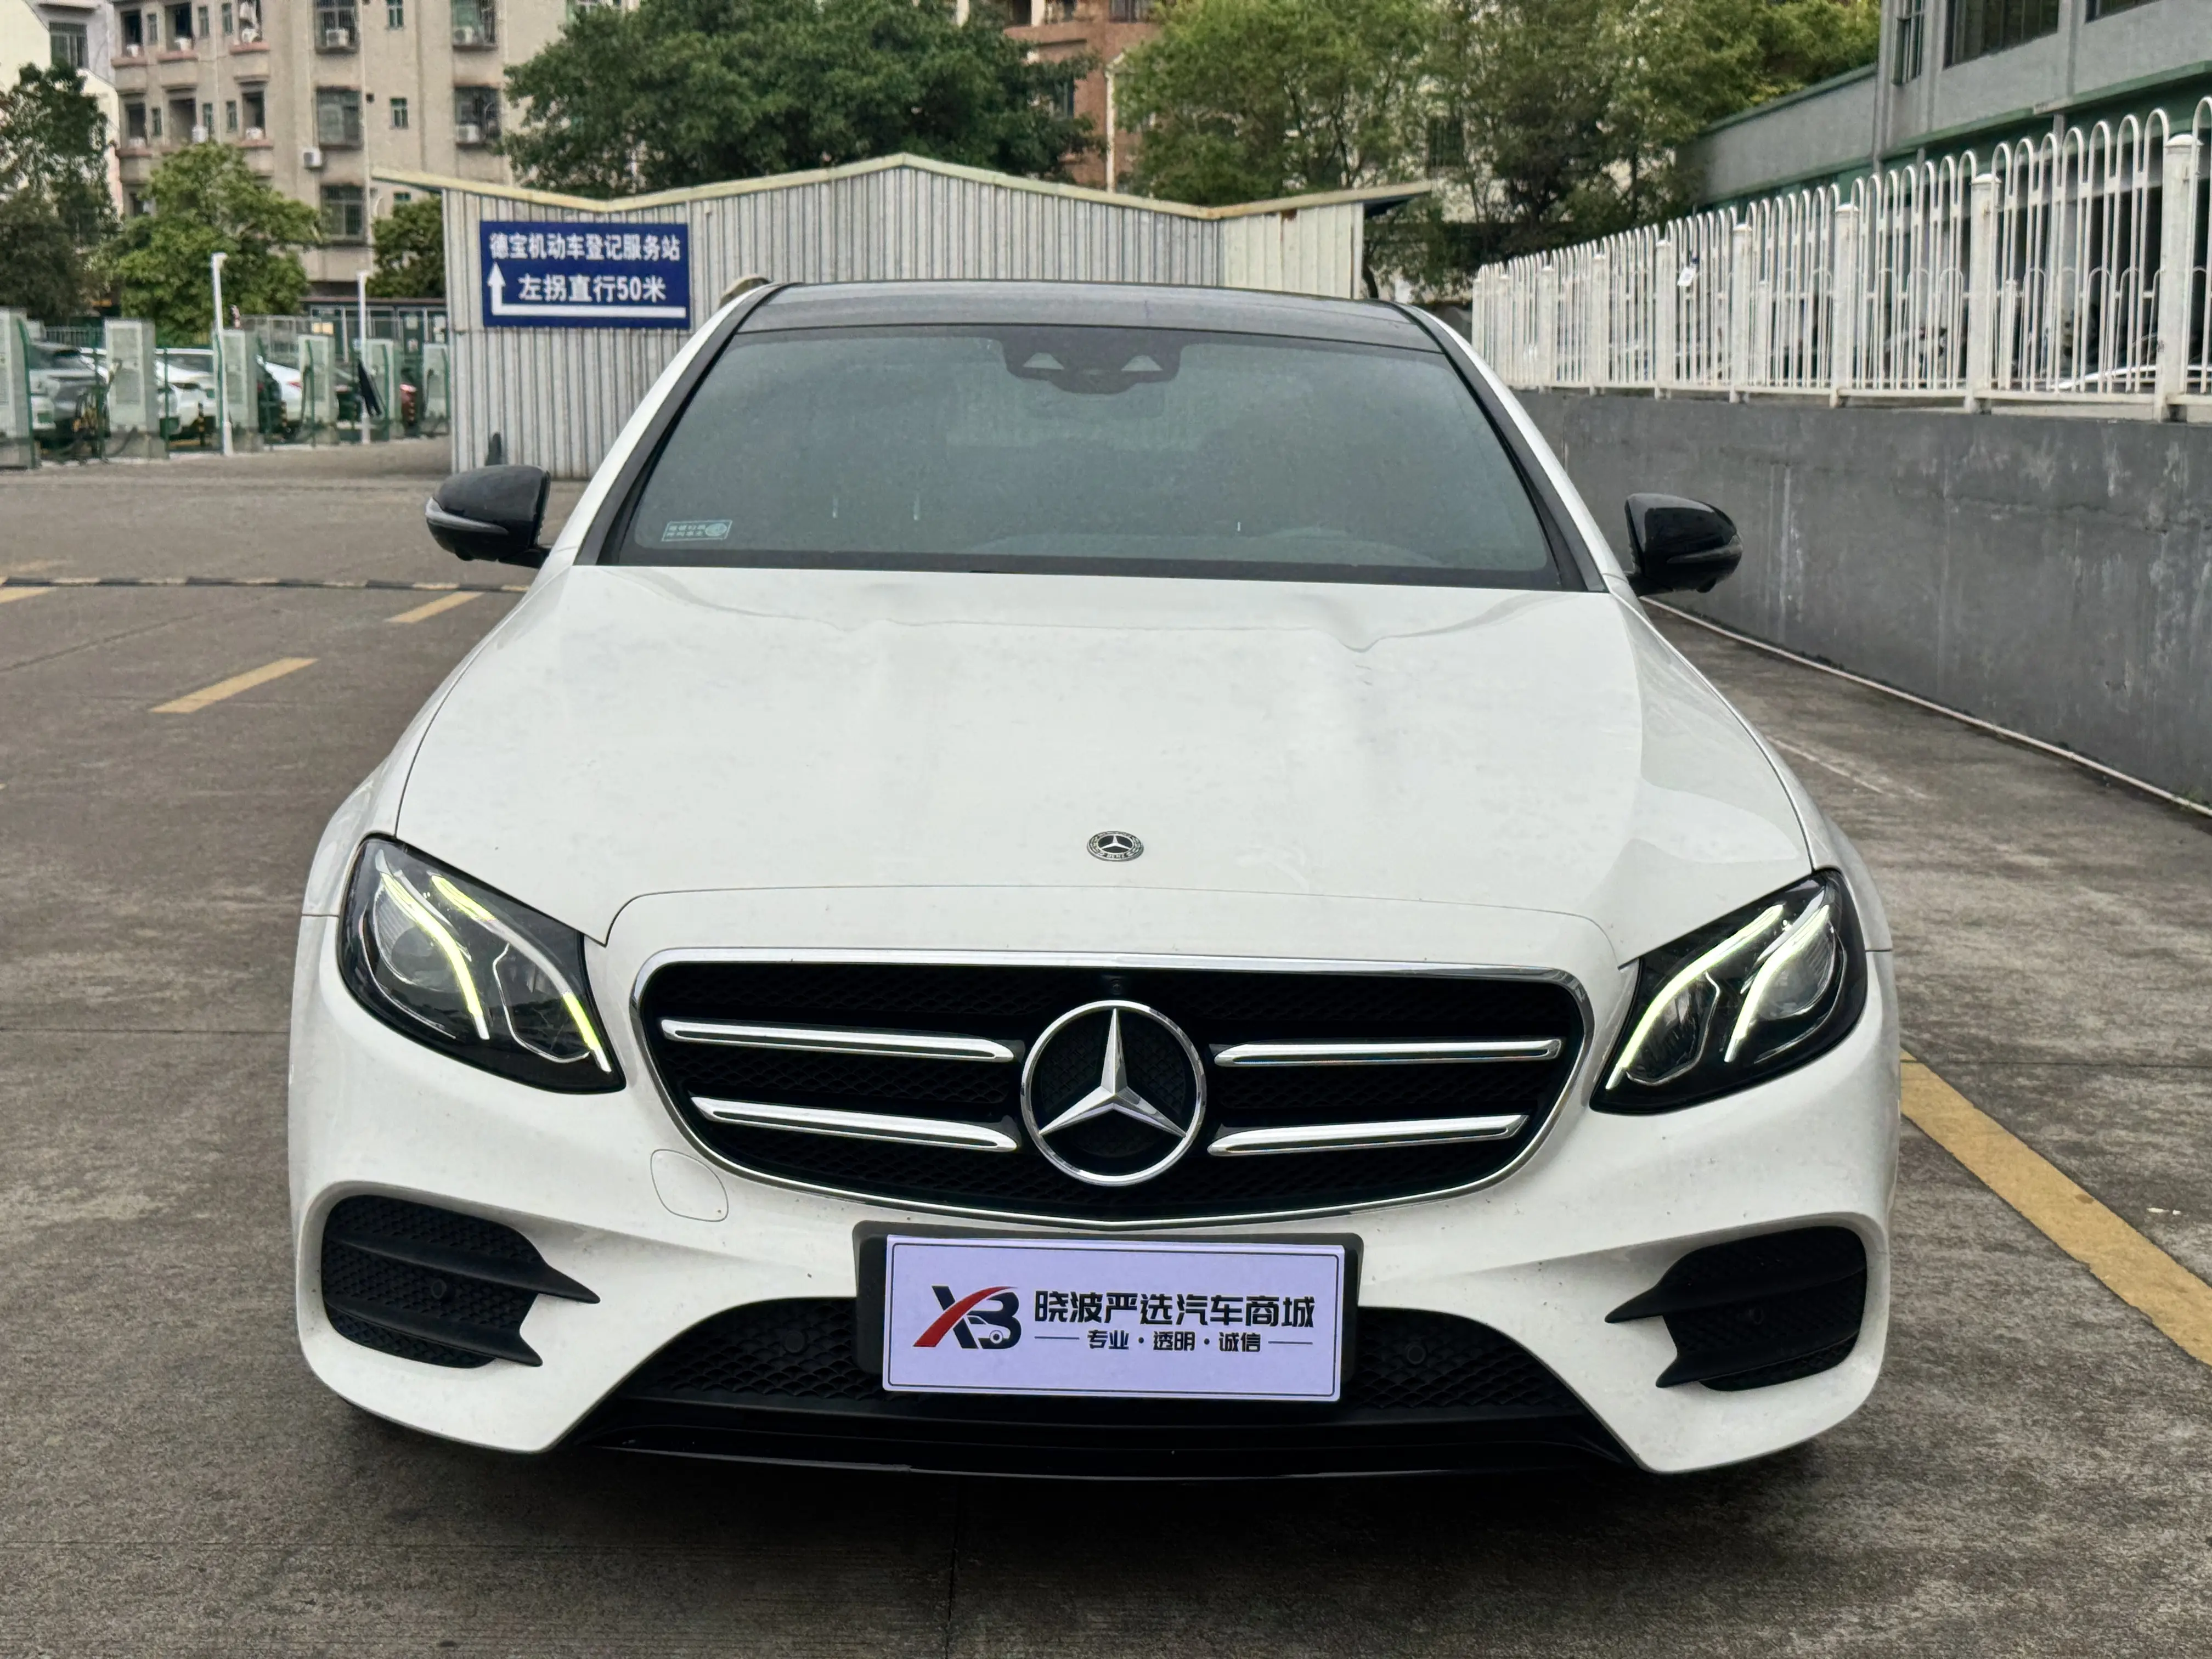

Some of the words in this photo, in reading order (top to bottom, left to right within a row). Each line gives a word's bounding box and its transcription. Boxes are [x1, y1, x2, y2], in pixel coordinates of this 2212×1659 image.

[489, 232, 680, 261] 德宝机动车登记服务站
[518, 273, 666, 302] 左拐直行50米
[1035, 1290, 1315, 1328] 晓波严选汽车商城
